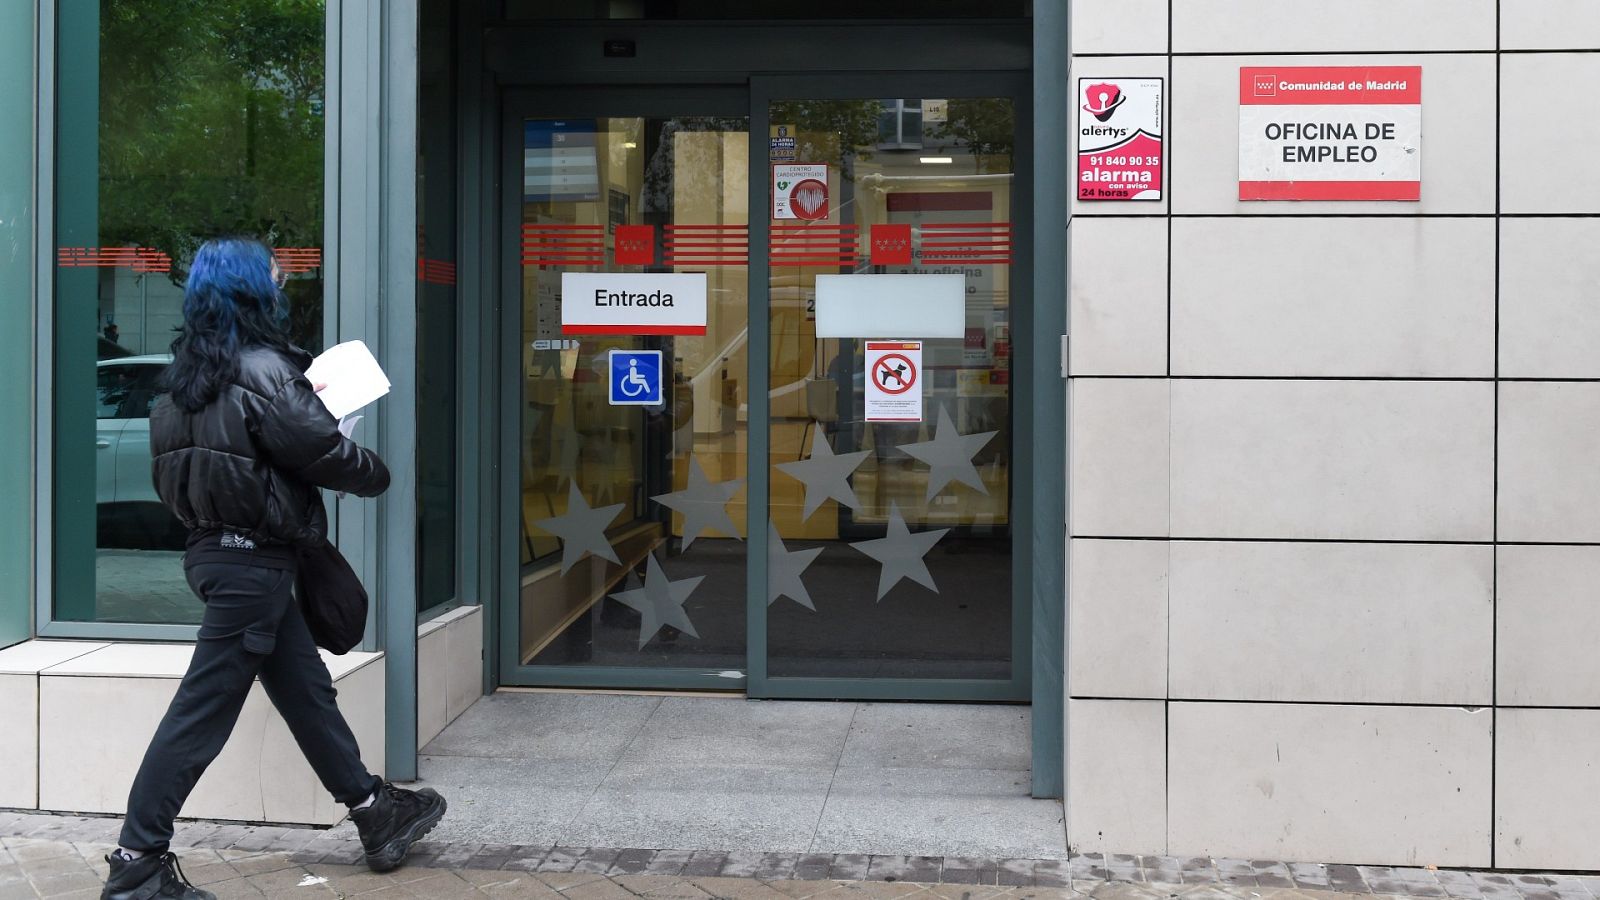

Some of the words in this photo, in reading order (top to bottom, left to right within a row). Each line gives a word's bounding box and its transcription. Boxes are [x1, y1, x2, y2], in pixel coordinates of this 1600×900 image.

[1279, 81, 1345, 91] Comunidad
[1348, 81, 1363, 91] de
[1366, 80, 1407, 90] Madrid
[1081, 125, 1127, 138] alertys
[1265, 122, 1358, 140] OFICINA
[1365, 123, 1395, 140] DE
[1090, 156, 1103, 166] 91
[1106, 156, 1127, 166] 840
[1129, 156, 1142, 166] 90
[1145, 156, 1159, 166] 35
[1282, 146, 1378, 163] EMPLEO
[1081, 167, 1152, 182] alarma
[1081, 188, 1095, 197] 24
[1098, 188, 1129, 197] horas
[594, 289, 675, 307] Entrada
